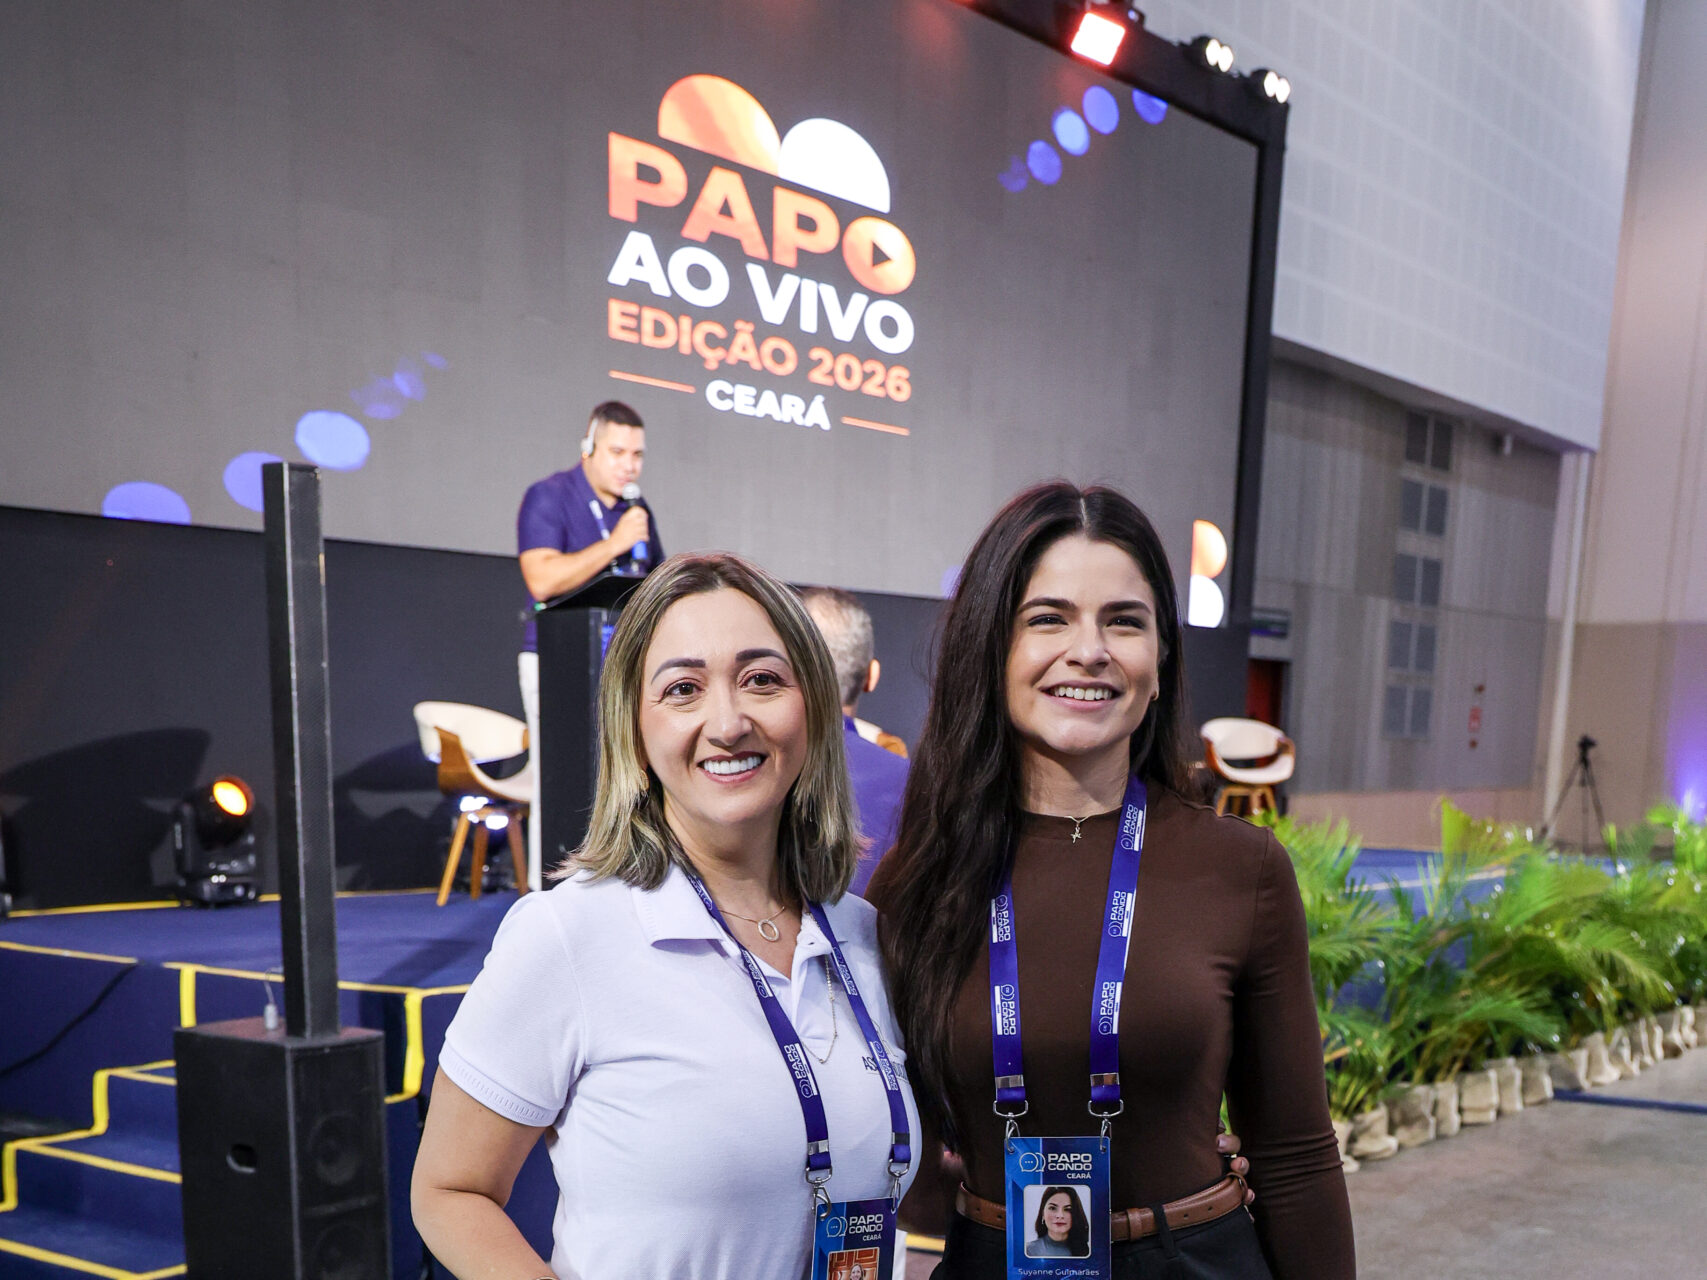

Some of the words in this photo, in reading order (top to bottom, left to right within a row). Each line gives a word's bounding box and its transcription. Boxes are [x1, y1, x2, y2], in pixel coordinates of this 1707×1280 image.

[608, 131, 917, 295] PAPO
[607, 230, 730, 308] AO
[746, 262, 915, 354] VIVO
[608, 298, 798, 376] EDIÇÃO
[807, 347, 912, 402] 2026
[705, 379, 831, 431] CEARÁ
[1122, 804, 1134, 834] PAPO
[1129, 807, 1139, 835] CONDO
[1110, 890, 1121, 921] PAPO
[1118, 891, 1127, 921] CONDO
[1001, 910, 1011, 941] PAPO
[1099, 981, 1110, 1015] PAPO
[1107, 981, 1116, 1015] CONDO
[1001, 1001, 1010, 1035] CONDO
[1007, 1001, 1017, 1035] PAPO
[784, 1045, 801, 1079] PAPO
[1047, 1153, 1093, 1163] PAPO
[1047, 1163, 1093, 1171] CONDO
[1066, 1171, 1092, 1179] CEARÁ
[848, 1223, 883, 1234] CONDO
[849, 1213, 884, 1226] PAPO
[862, 1232, 882, 1241] CEARÁ
[1018, 1268, 1054, 1277] Suyanne
